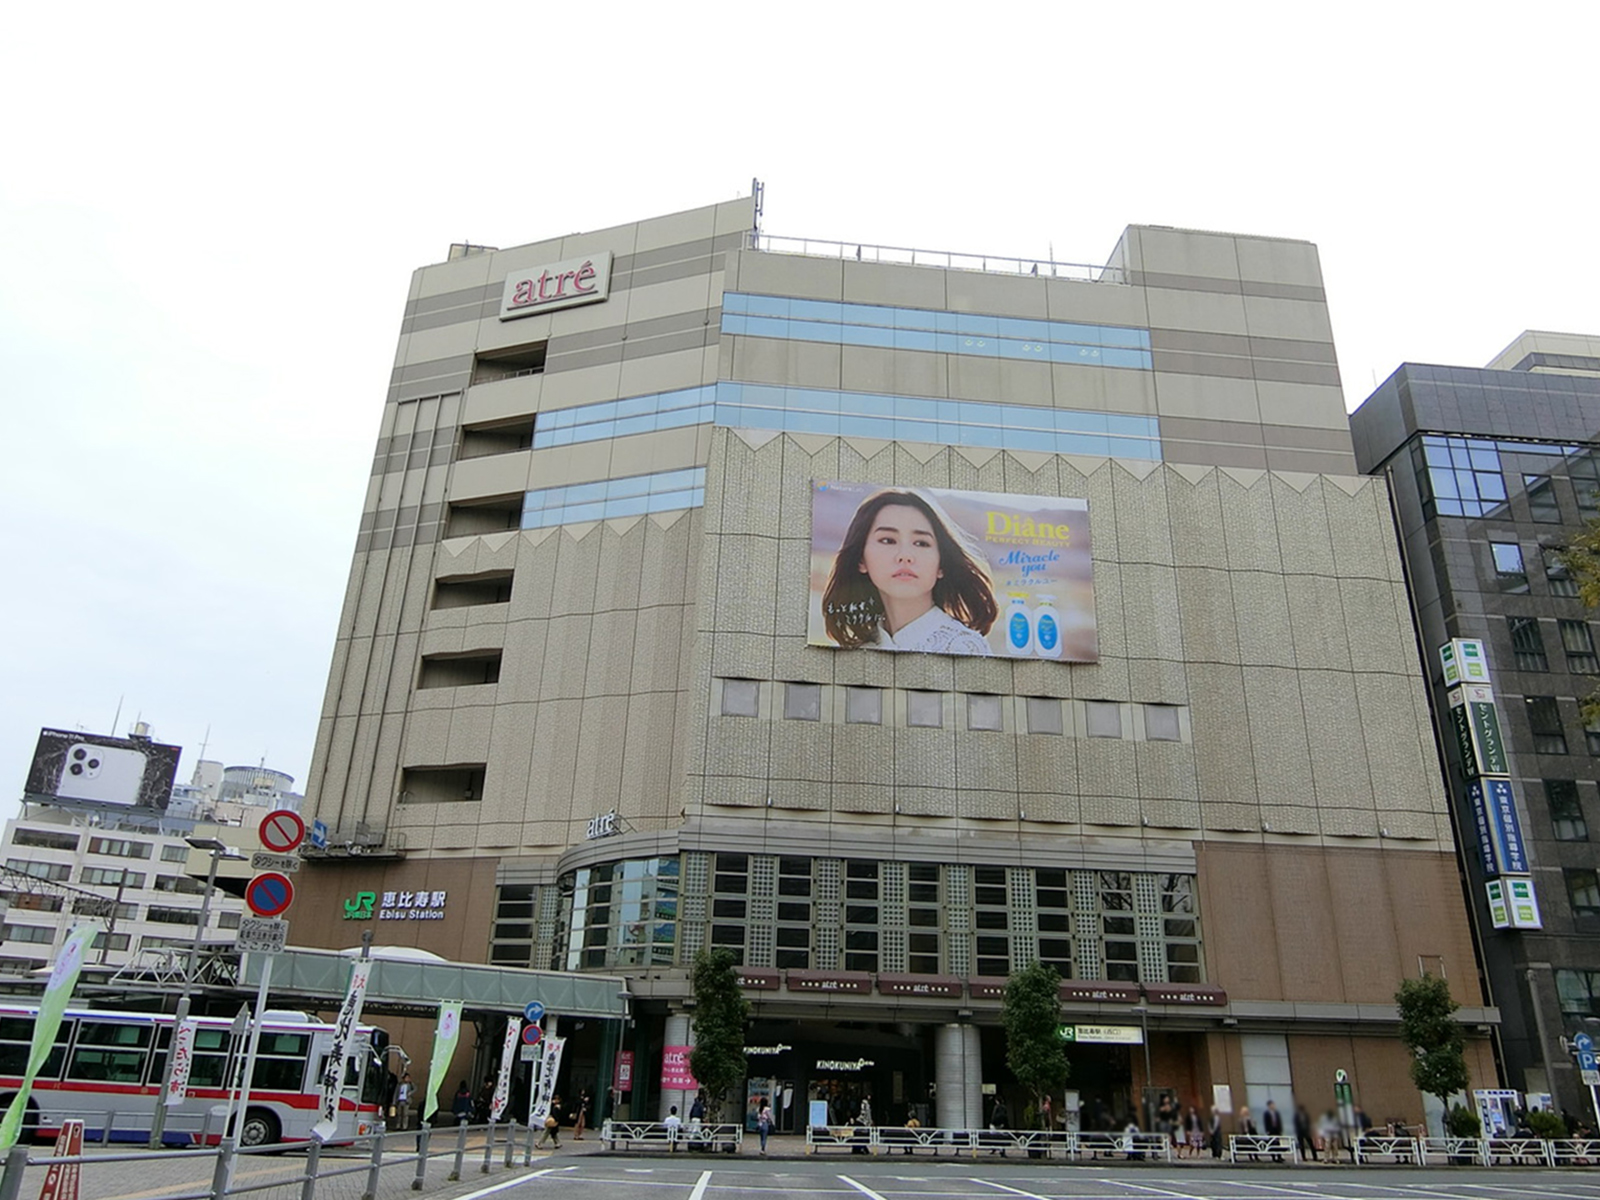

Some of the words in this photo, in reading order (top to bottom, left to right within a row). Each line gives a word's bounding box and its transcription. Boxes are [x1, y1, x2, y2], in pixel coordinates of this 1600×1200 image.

[512, 260, 596, 305] atré
[985, 535, 1029, 546] PERFECT
[1031, 539, 1071, 548] BEAUTY
[999, 550, 1060, 565] Miracle
[1021, 563, 1046, 578] you
[48, 731, 69, 740] iPhone
[1499, 796, 1523, 871] 東京個別指導学院
[253, 855, 298, 870] タクシーを除く
[344, 891, 377, 911] JR
[381, 891, 447, 909] 恵比寿駅
[379, 910, 407, 919] Ebisu
[409, 910, 445, 919] Station
[238, 941, 282, 953] ここから
[1060, 1027, 1074, 1038] JR
[816, 1060, 861, 1071] KINOKUNIYA
[1582, 1053, 1593, 1068] P
